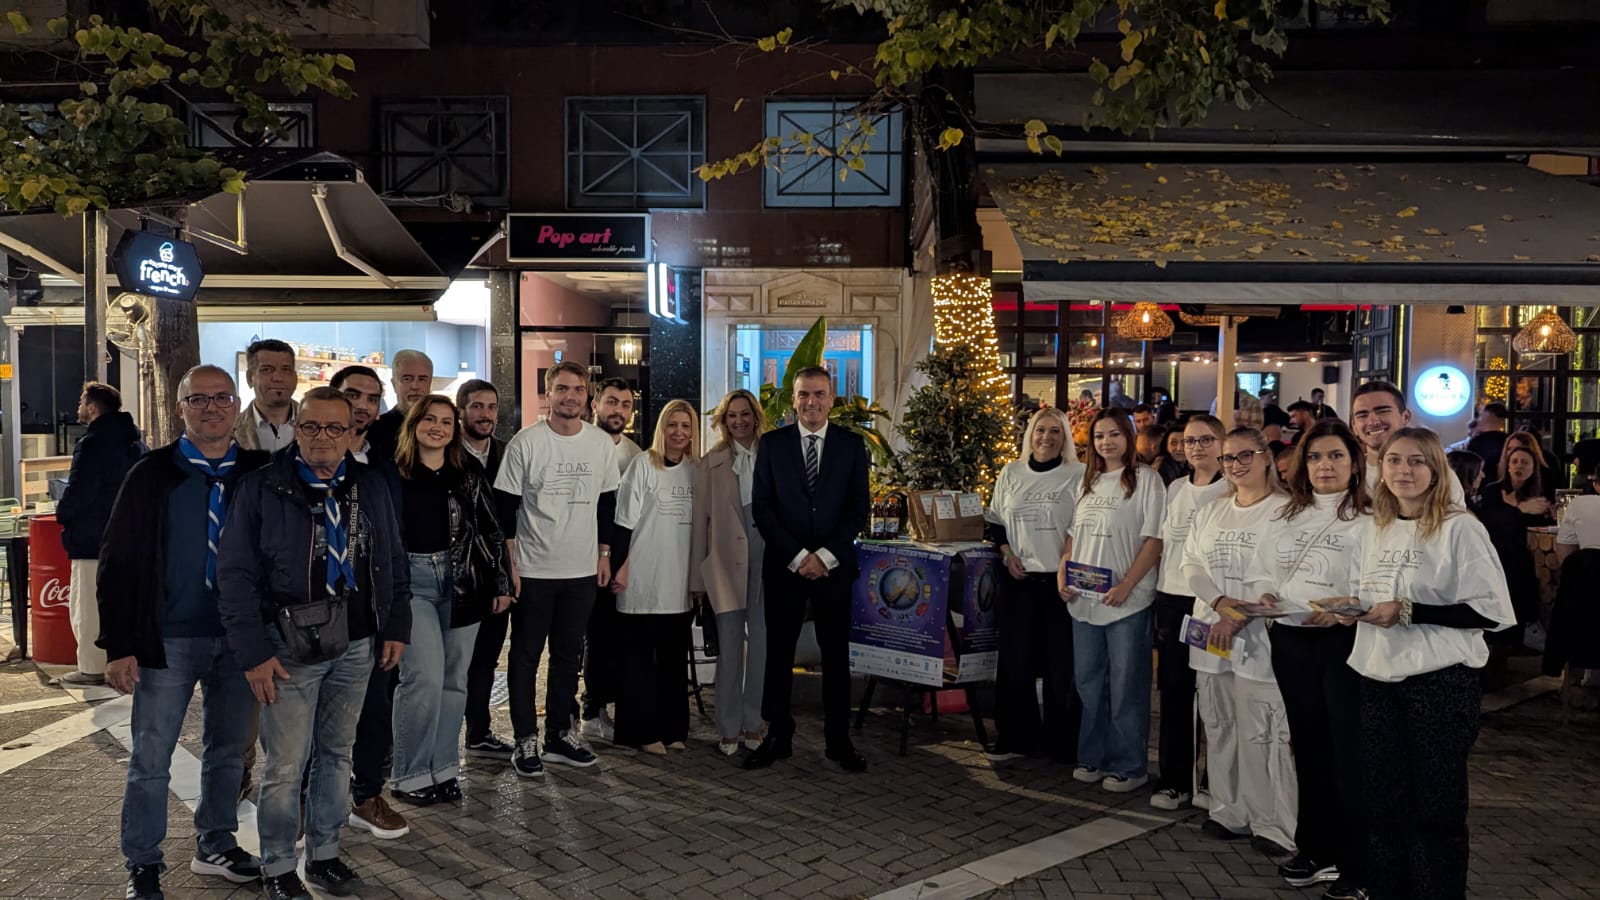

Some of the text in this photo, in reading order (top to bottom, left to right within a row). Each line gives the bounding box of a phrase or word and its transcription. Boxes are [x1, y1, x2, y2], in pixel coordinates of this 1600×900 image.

[537, 225, 612, 248] Pop art
[40, 578, 71, 609] Coc
